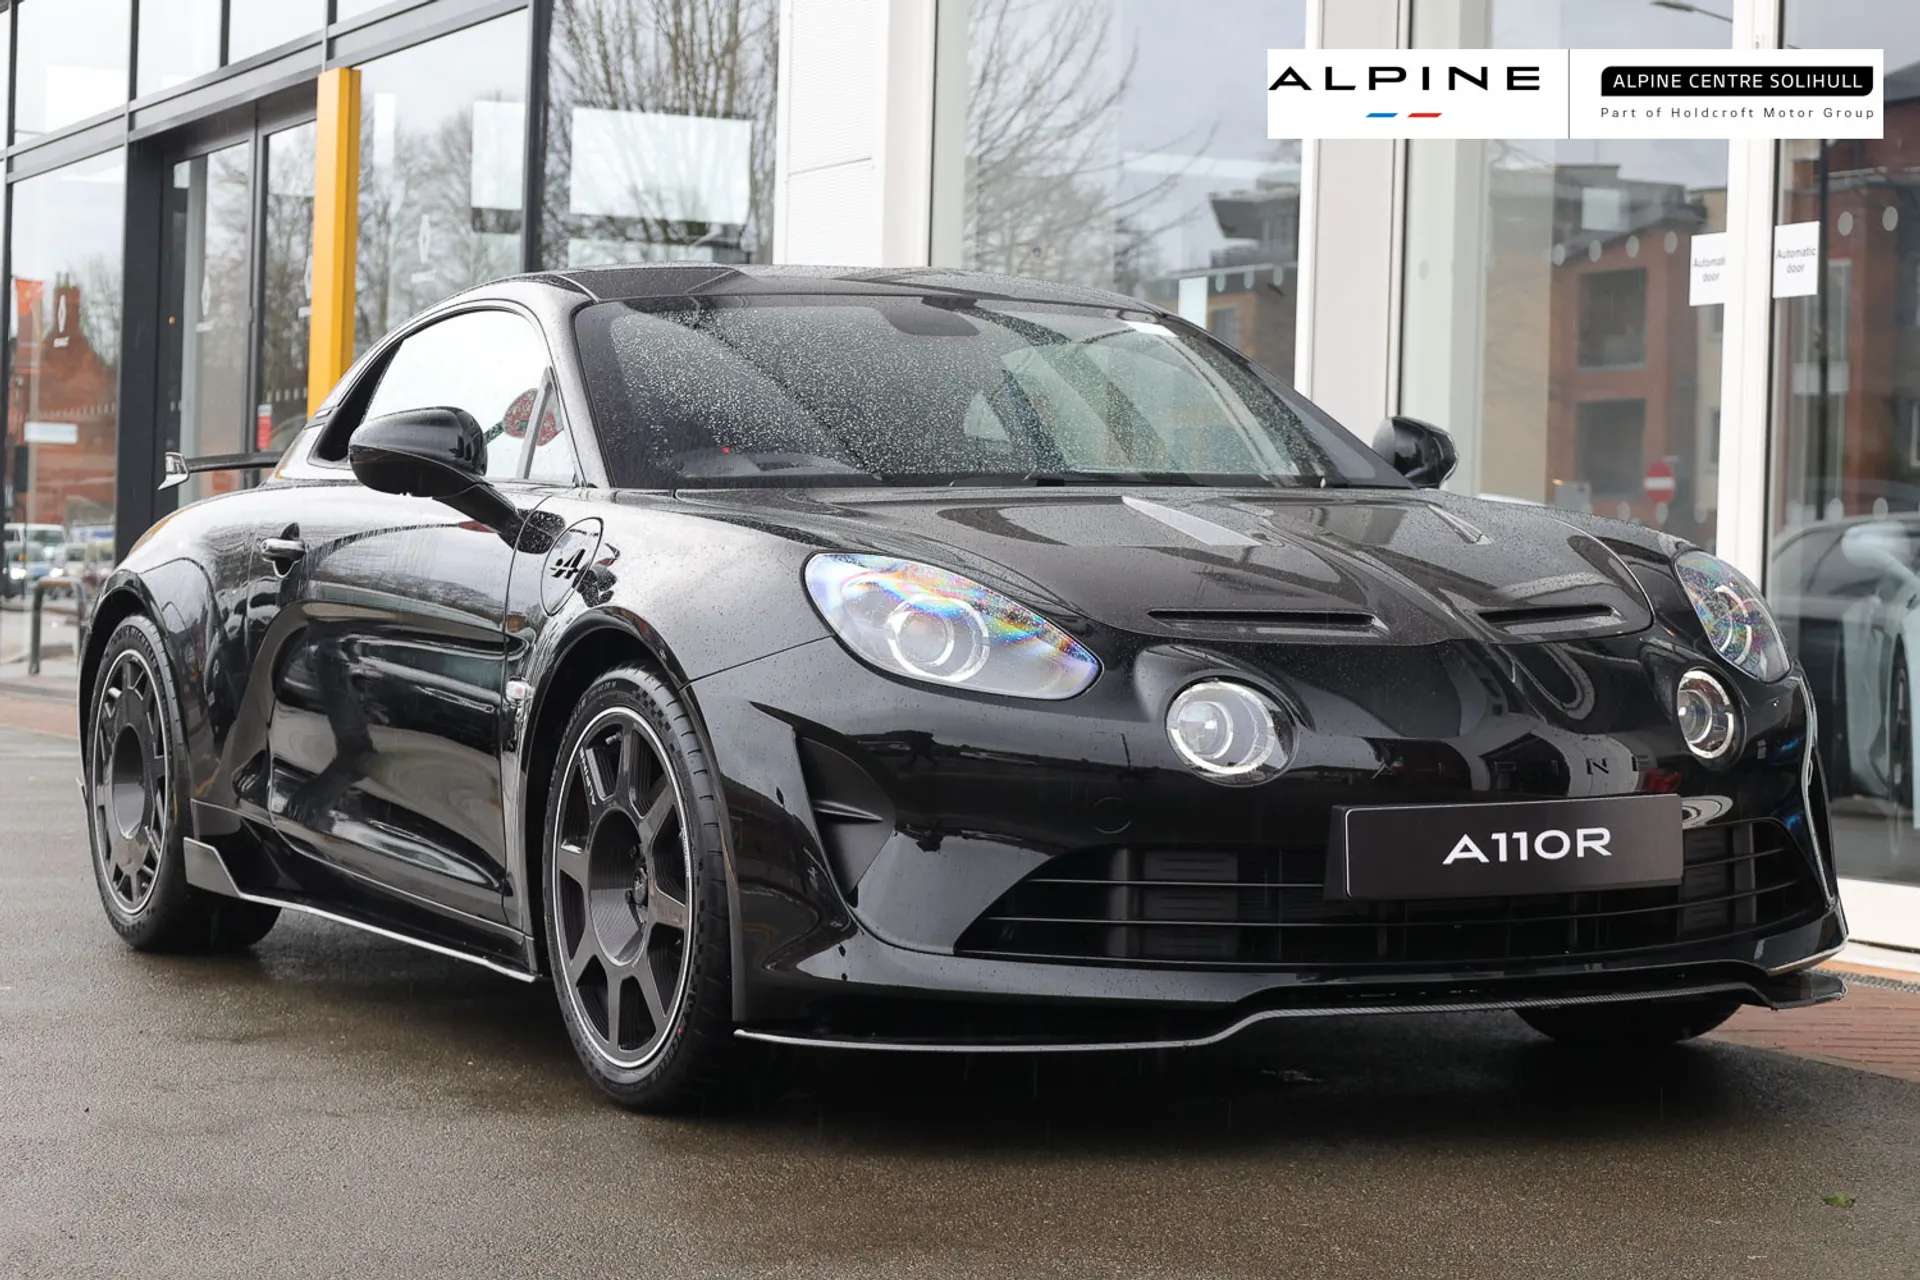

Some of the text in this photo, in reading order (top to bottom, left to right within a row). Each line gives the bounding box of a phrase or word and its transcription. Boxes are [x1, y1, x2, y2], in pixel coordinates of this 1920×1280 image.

[1776, 246, 1816, 259] Automatic
[1694, 256, 1726, 267] Automati
[1786, 263, 1805, 274] door
[1703, 272, 1720, 282] door
[1441, 826, 1613, 866] A110R
